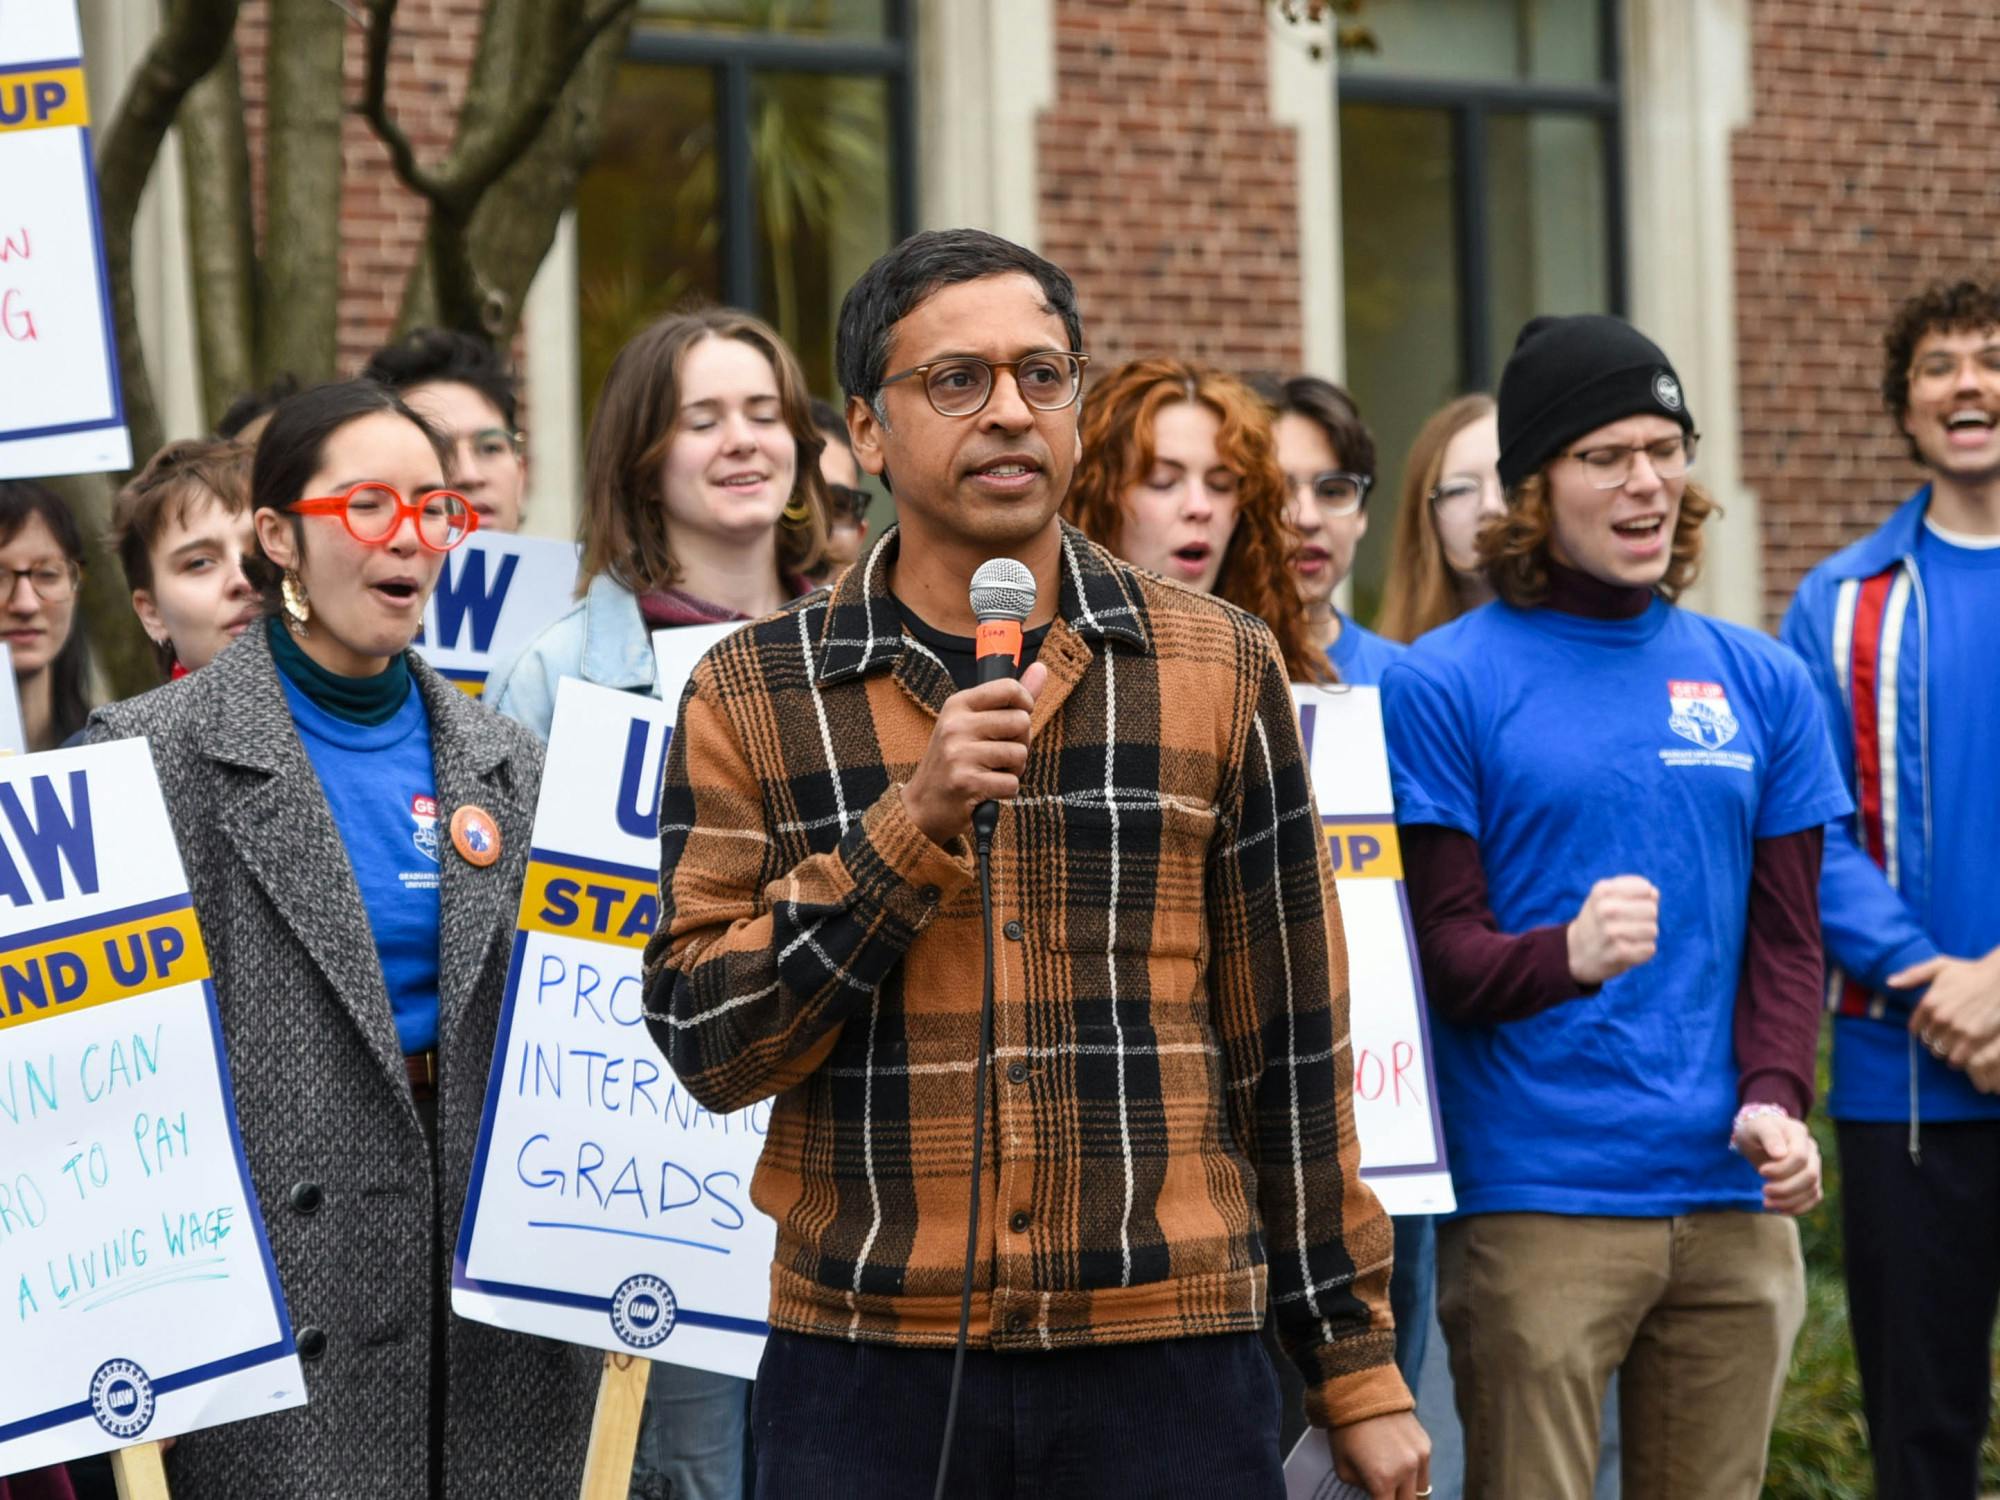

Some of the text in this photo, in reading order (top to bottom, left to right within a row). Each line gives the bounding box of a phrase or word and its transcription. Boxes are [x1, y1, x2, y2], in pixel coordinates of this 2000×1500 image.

[0, 81, 66, 125] UP
[411, 547, 521, 655] W
[616, 716, 674, 840] U
[0, 926, 185, 1018] ND UP
[80, 1023, 162, 1104] CAN
[1355, 1040, 1422, 1106] OR
[62, 1141, 108, 1200] TO
[134, 1112, 189, 1178] PAY
[517, 1133, 744, 1230] GRADS
[18, 1206, 234, 1323] A LIVING WAGE
[629, 1301, 658, 1320] UAW
[107, 1387, 135, 1409] UAW
